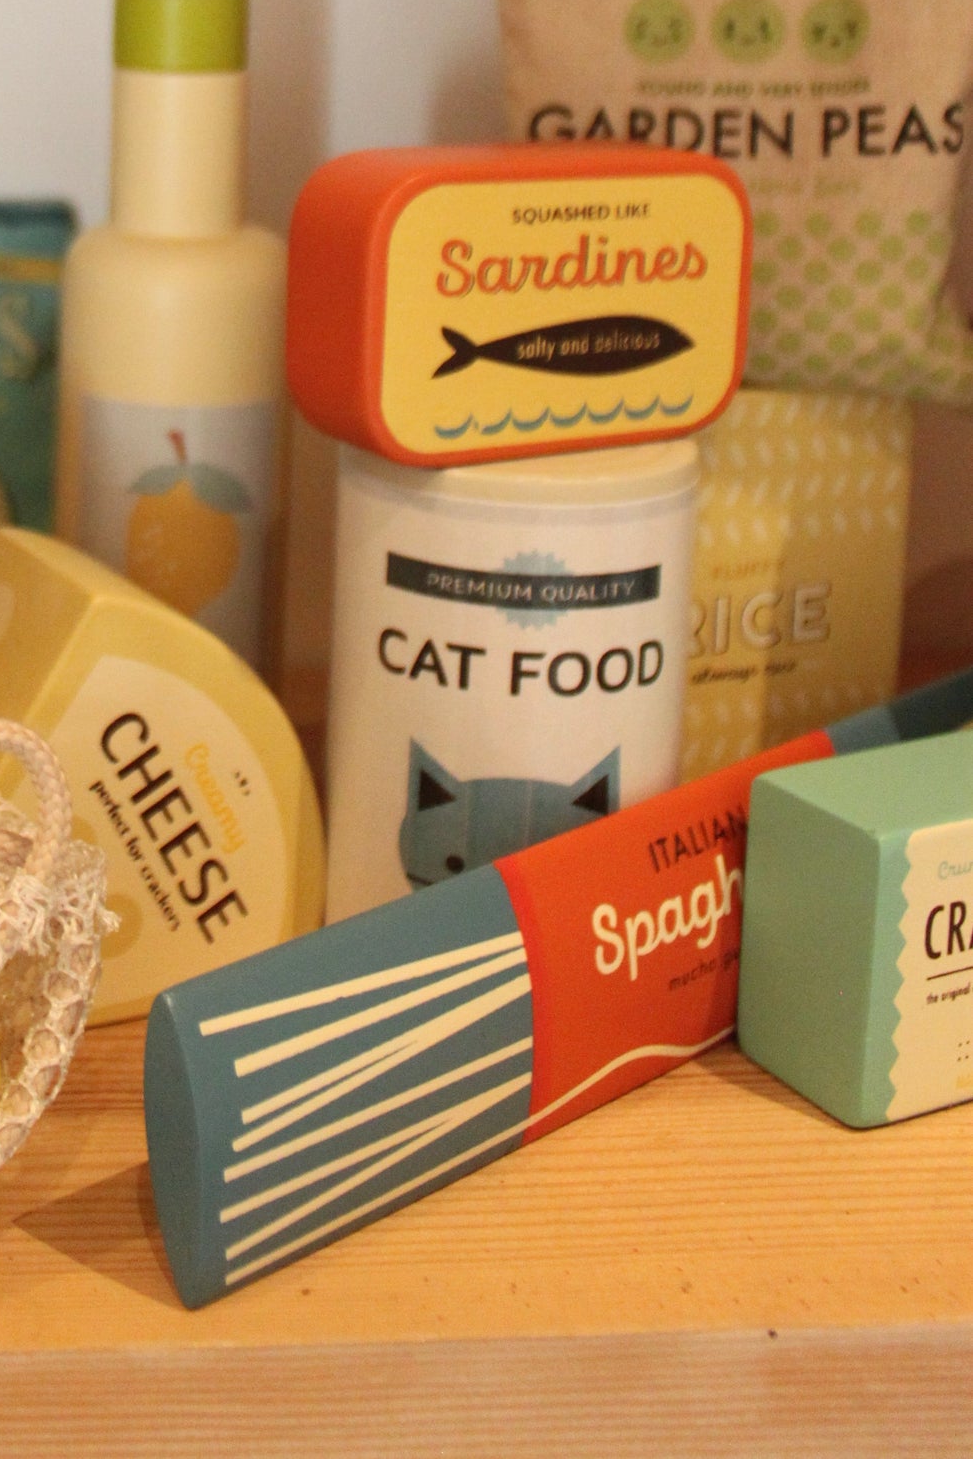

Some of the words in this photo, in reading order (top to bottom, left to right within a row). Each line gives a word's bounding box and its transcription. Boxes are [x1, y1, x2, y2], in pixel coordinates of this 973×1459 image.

[528, 103, 795, 158] GARDEN
[820, 102, 966, 158] PEAS
[512, 204, 610, 225] SQUASHED
[616, 203, 651, 220] LIKE
[436, 234, 707, 298] Sardines
[517, 336, 556, 362] salty
[560, 335, 590, 356] and
[594, 329, 661, 353] delicious
[427, 573, 533, 602] PREMIUM
[540, 580, 636, 603] QUALITY
[378, 628, 487, 691] CAT
[509, 639, 665, 697] FOOD
[88, 780, 130, 837] perfect
[125, 835, 144, 862] for
[141, 865, 181, 932] crackers
[100, 712, 249, 946] CHEESE
[648, 803, 747, 873] ITALIAN
[591, 853, 744, 981] Spagh
